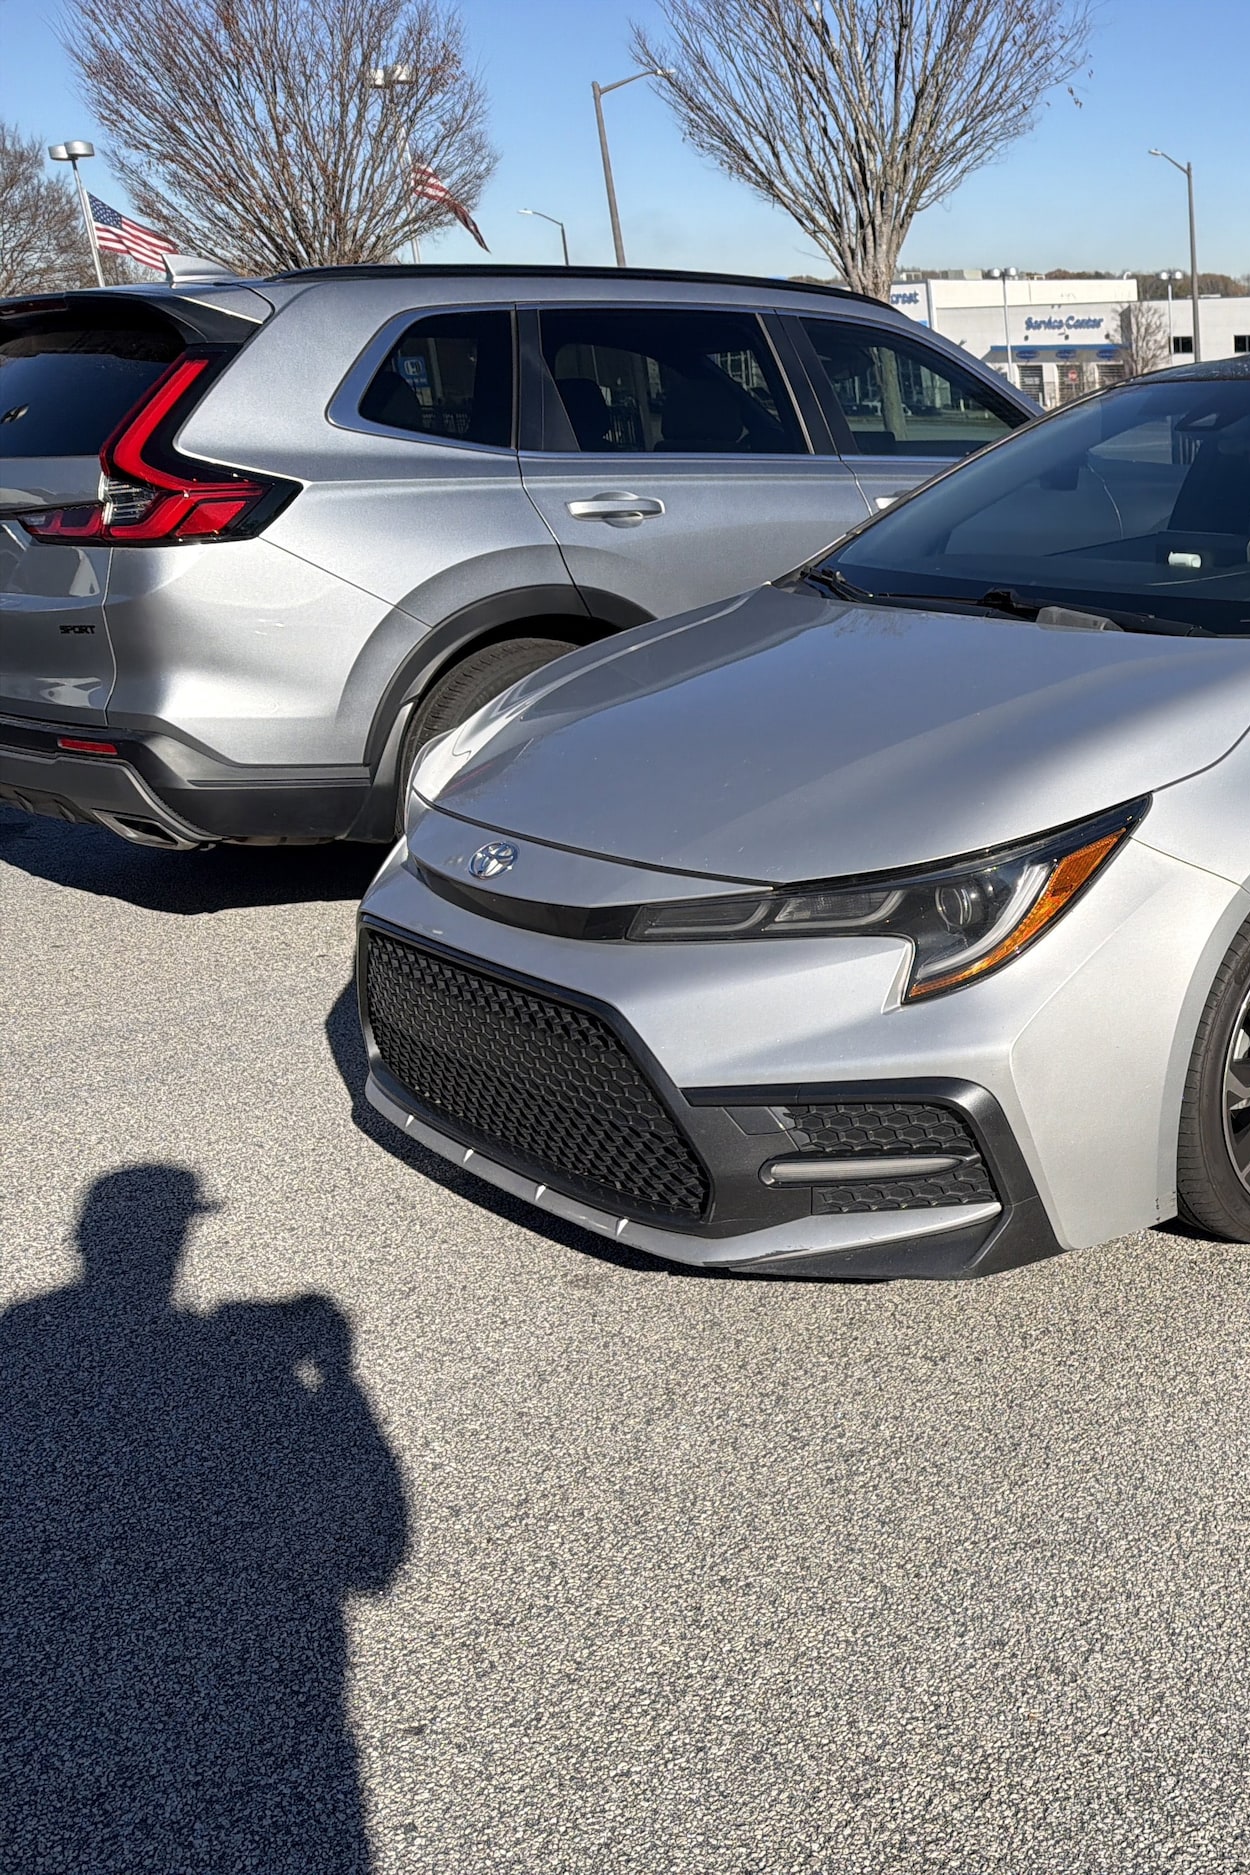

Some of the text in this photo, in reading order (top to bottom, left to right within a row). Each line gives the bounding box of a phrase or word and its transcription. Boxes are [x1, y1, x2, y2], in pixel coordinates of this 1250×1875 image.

[1025, 315, 1104, 331] Service Center
[60, 625, 95, 634] SPORT
